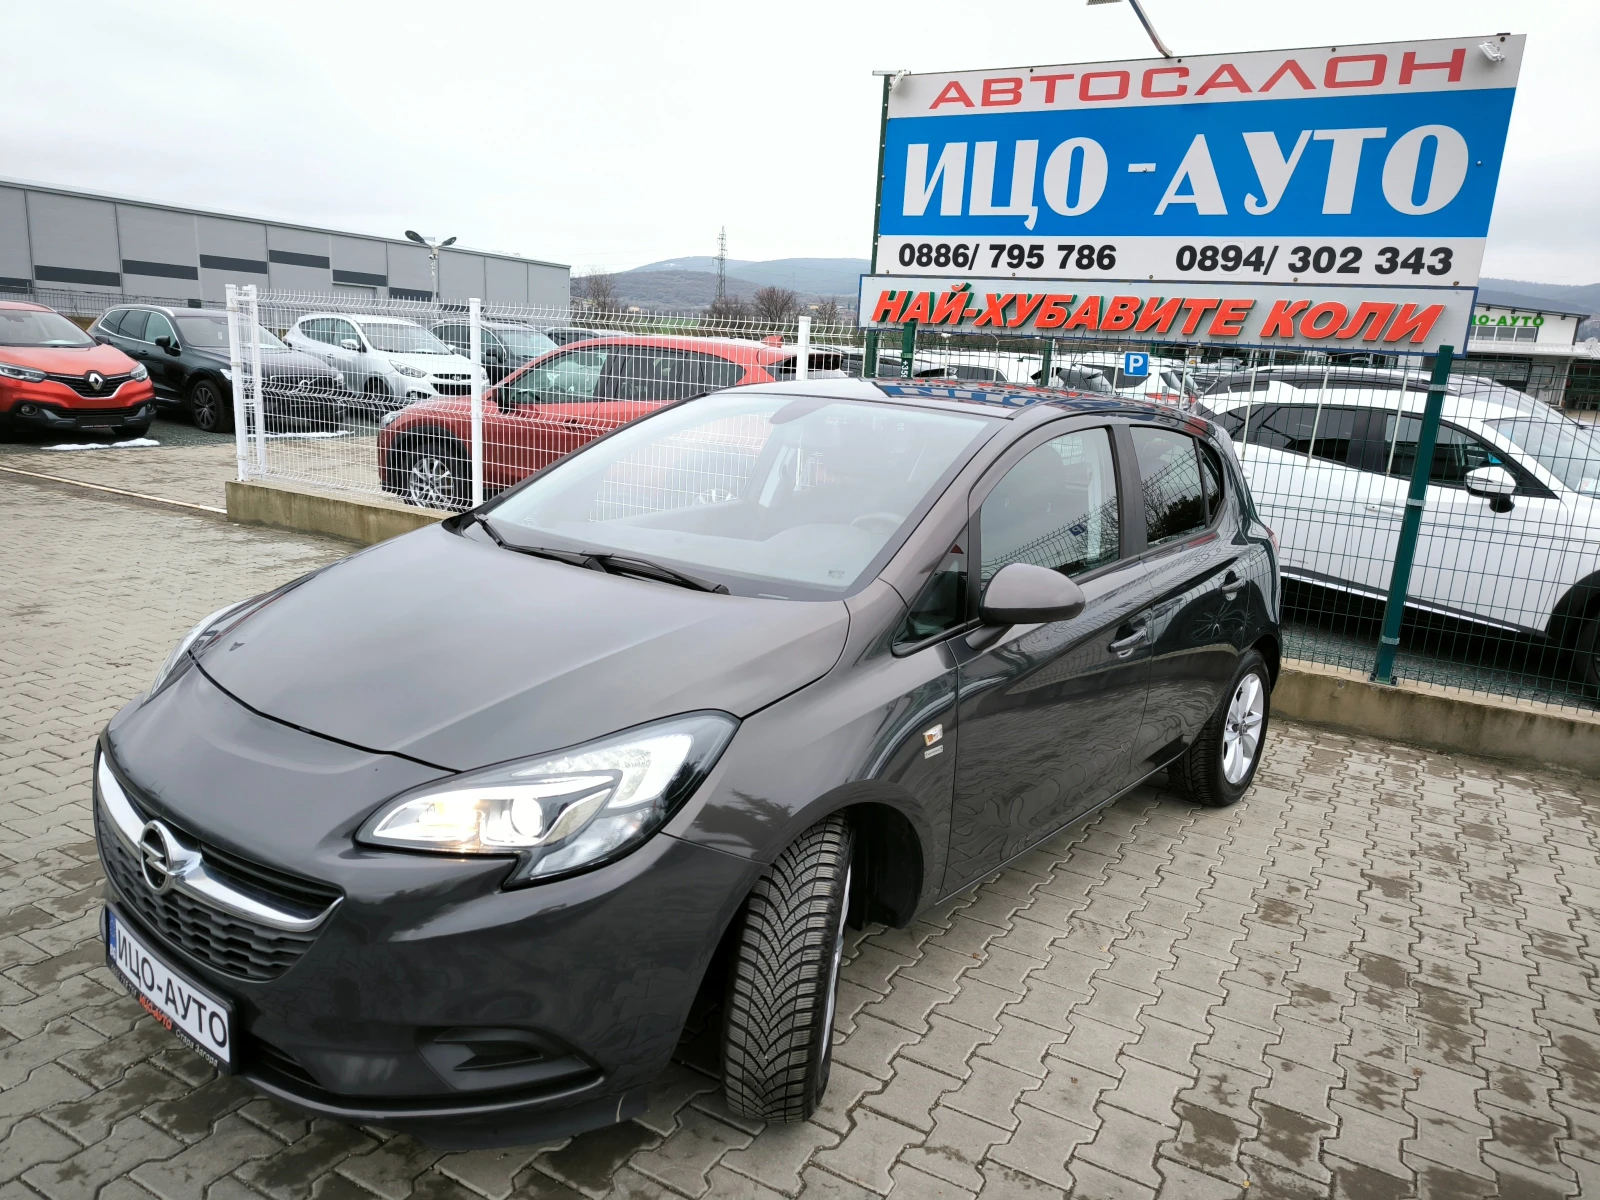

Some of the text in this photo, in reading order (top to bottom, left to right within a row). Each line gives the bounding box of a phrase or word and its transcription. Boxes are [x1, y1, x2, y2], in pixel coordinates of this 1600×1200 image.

[930, 49, 1466, 110] АВТОСАЛОН
[899, 243, 1117, 271] 0886/ 795 786
[1176, 245, 1453, 276] 0894/ 302 343
[871, 282, 1446, 344] НАЙ-ХУБАВИТЕ КОЛИ
[1129, 354, 1144, 373] P
[117, 928, 228, 1048] ИЦО-АУТО
